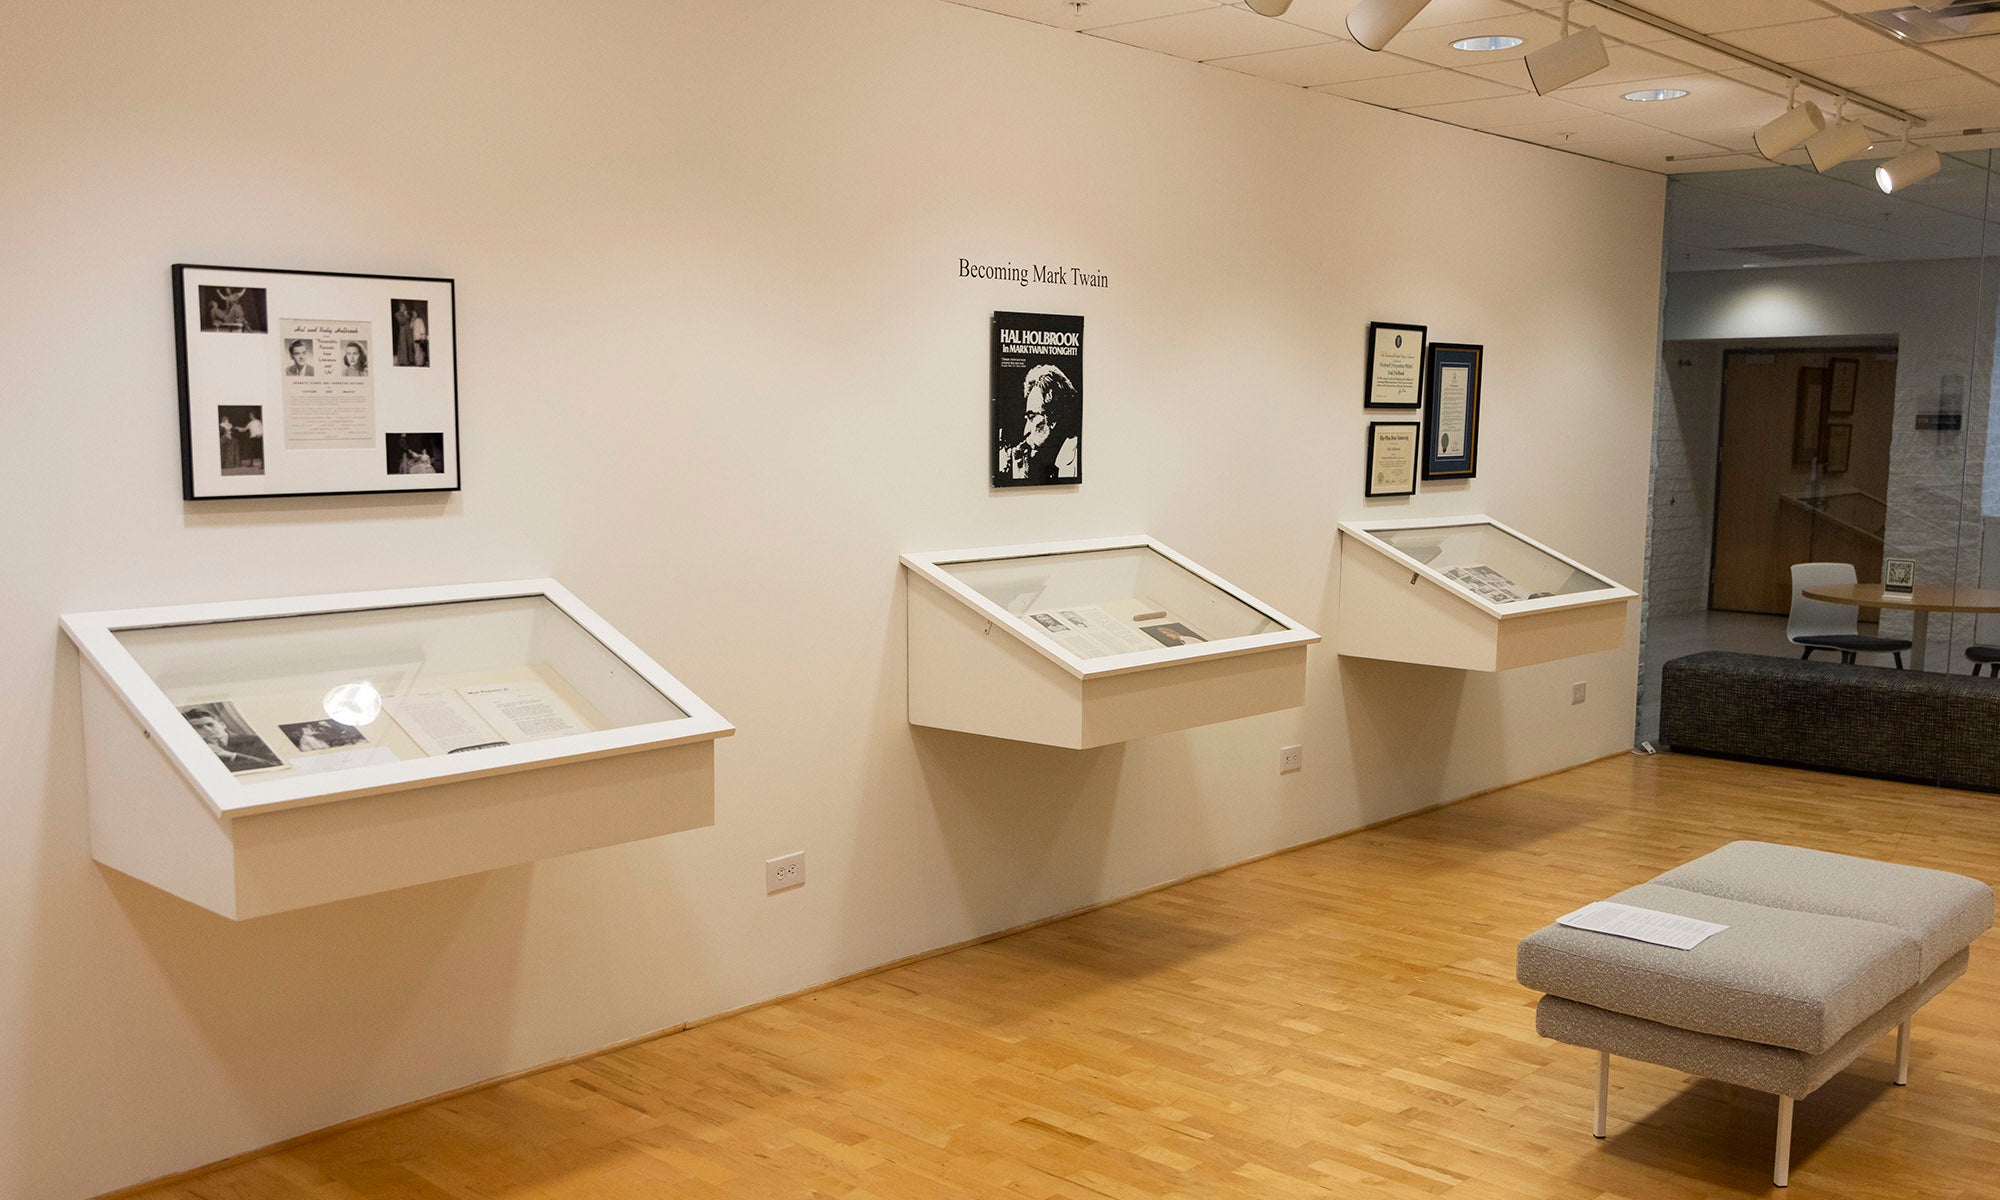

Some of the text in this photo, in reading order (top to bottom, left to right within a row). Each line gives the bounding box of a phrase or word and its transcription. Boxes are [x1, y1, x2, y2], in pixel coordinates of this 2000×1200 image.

[959, 258, 1108, 288] Becoming Mark Twain
[1000, 329, 1079, 347] HAL HOLBROOK
[1002, 343, 1078, 356] in MARK TWAIN TONIGHT!
